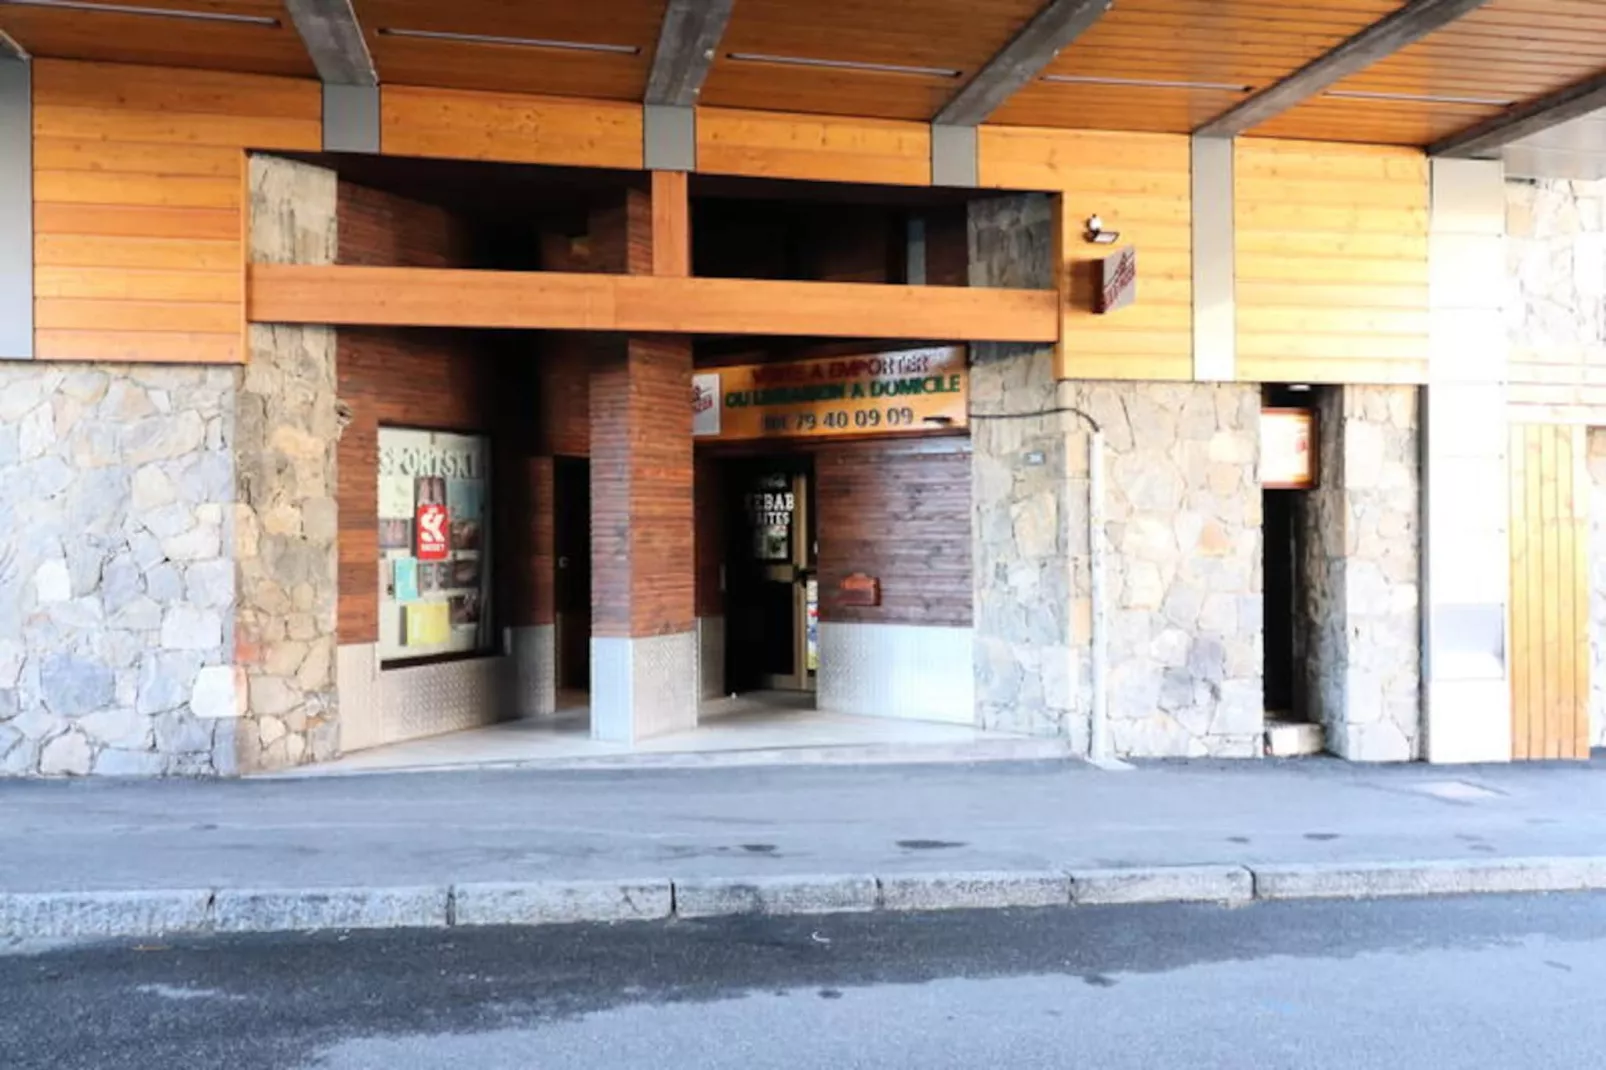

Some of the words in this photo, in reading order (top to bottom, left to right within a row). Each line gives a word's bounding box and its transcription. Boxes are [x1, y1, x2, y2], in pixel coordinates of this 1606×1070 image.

[870, 374, 961, 397] DOMICILE
[822, 410, 849, 428] 40
[854, 409, 881, 427] 09
[886, 407, 914, 426] 09
